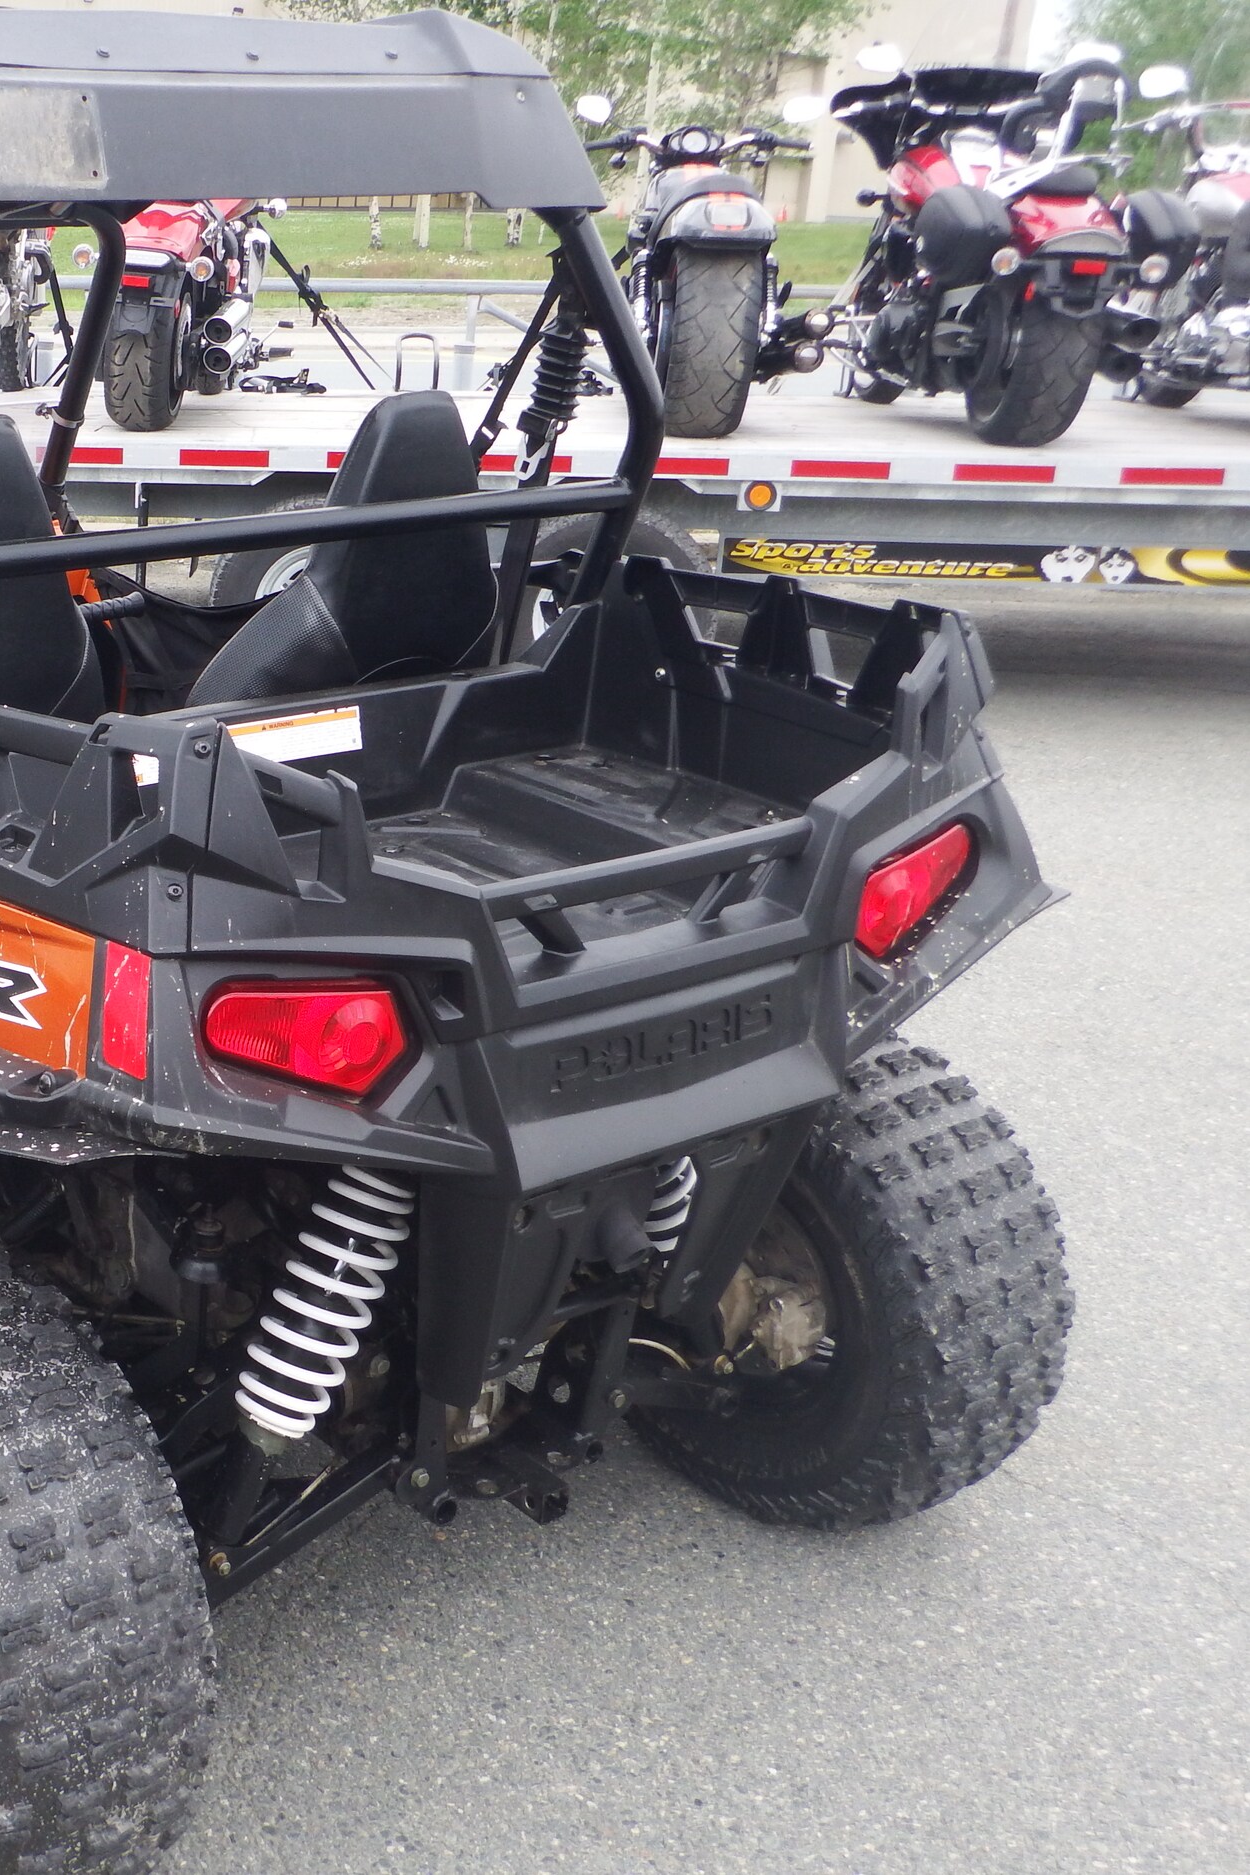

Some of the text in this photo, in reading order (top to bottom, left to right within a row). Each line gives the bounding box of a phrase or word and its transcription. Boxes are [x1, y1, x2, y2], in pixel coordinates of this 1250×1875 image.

[730, 538, 877, 560] Sports
[796, 556, 1014, 577] adventure
[268, 720, 294, 729] WARNING
[551, 994, 772, 1093] POLARIS
